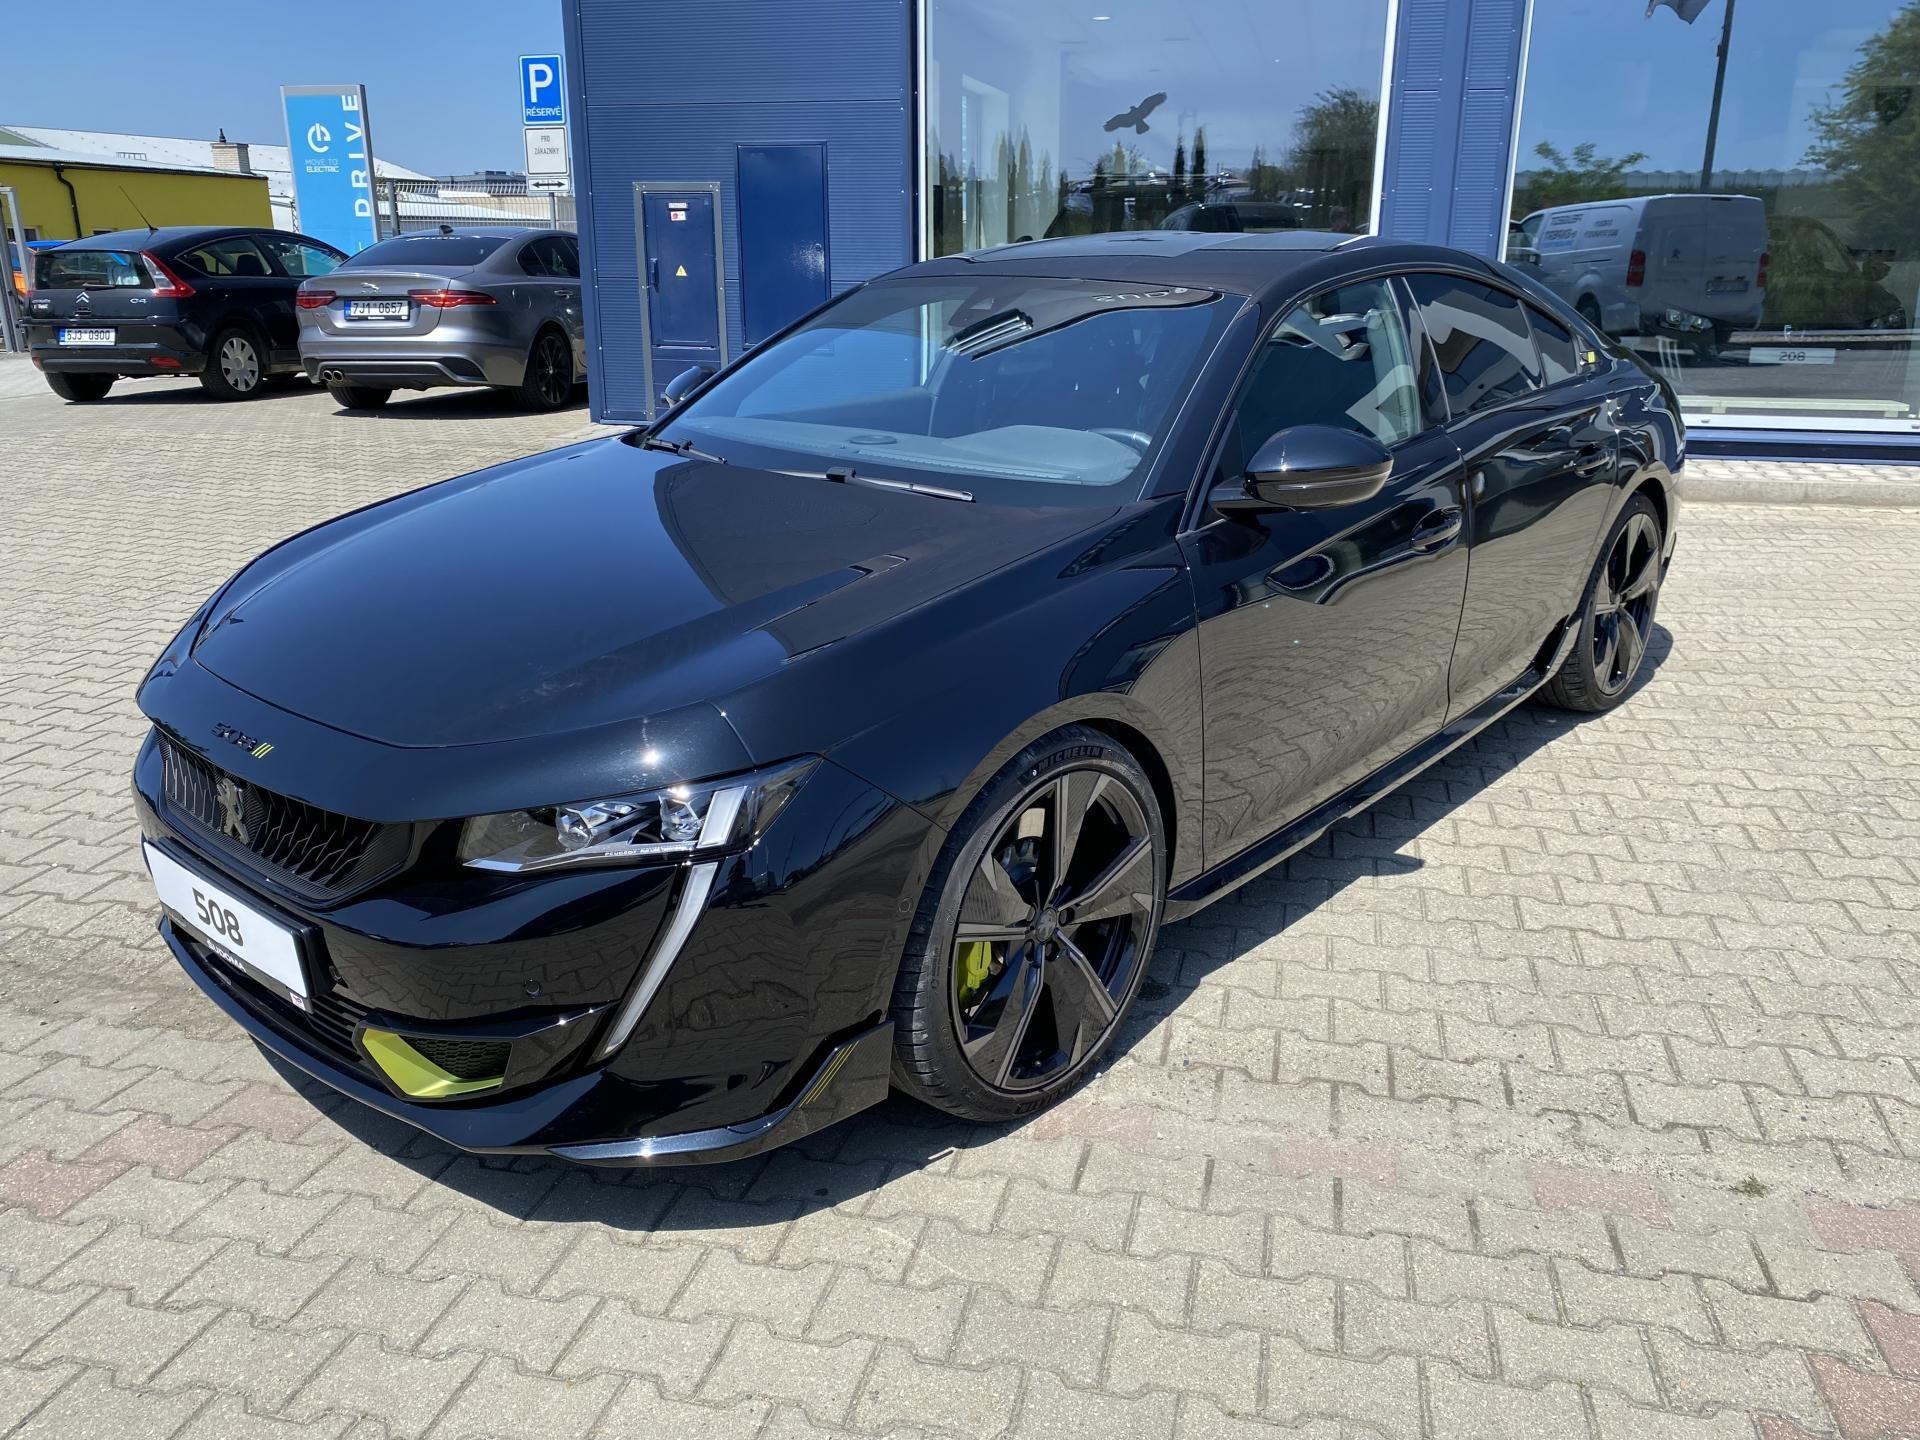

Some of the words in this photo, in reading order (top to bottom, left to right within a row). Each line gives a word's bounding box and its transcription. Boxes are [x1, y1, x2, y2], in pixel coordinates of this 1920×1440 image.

[528, 63, 553, 103] P
[526, 106, 561, 117] RÉSERVÉ
[327, 158, 338, 166] TO
[342, 95, 371, 217] DRIVE
[306, 165, 340, 173] ELECTRIC
[353, 302, 371, 314] 7J1
[378, 302, 403, 314] 0657
[67, 330, 83, 340] 5J3
[88, 330, 111, 340] 0900
[211, 722, 258, 752] 508
[1038, 746, 1101, 770] MICHELIN
[191, 886, 244, 947] 508
